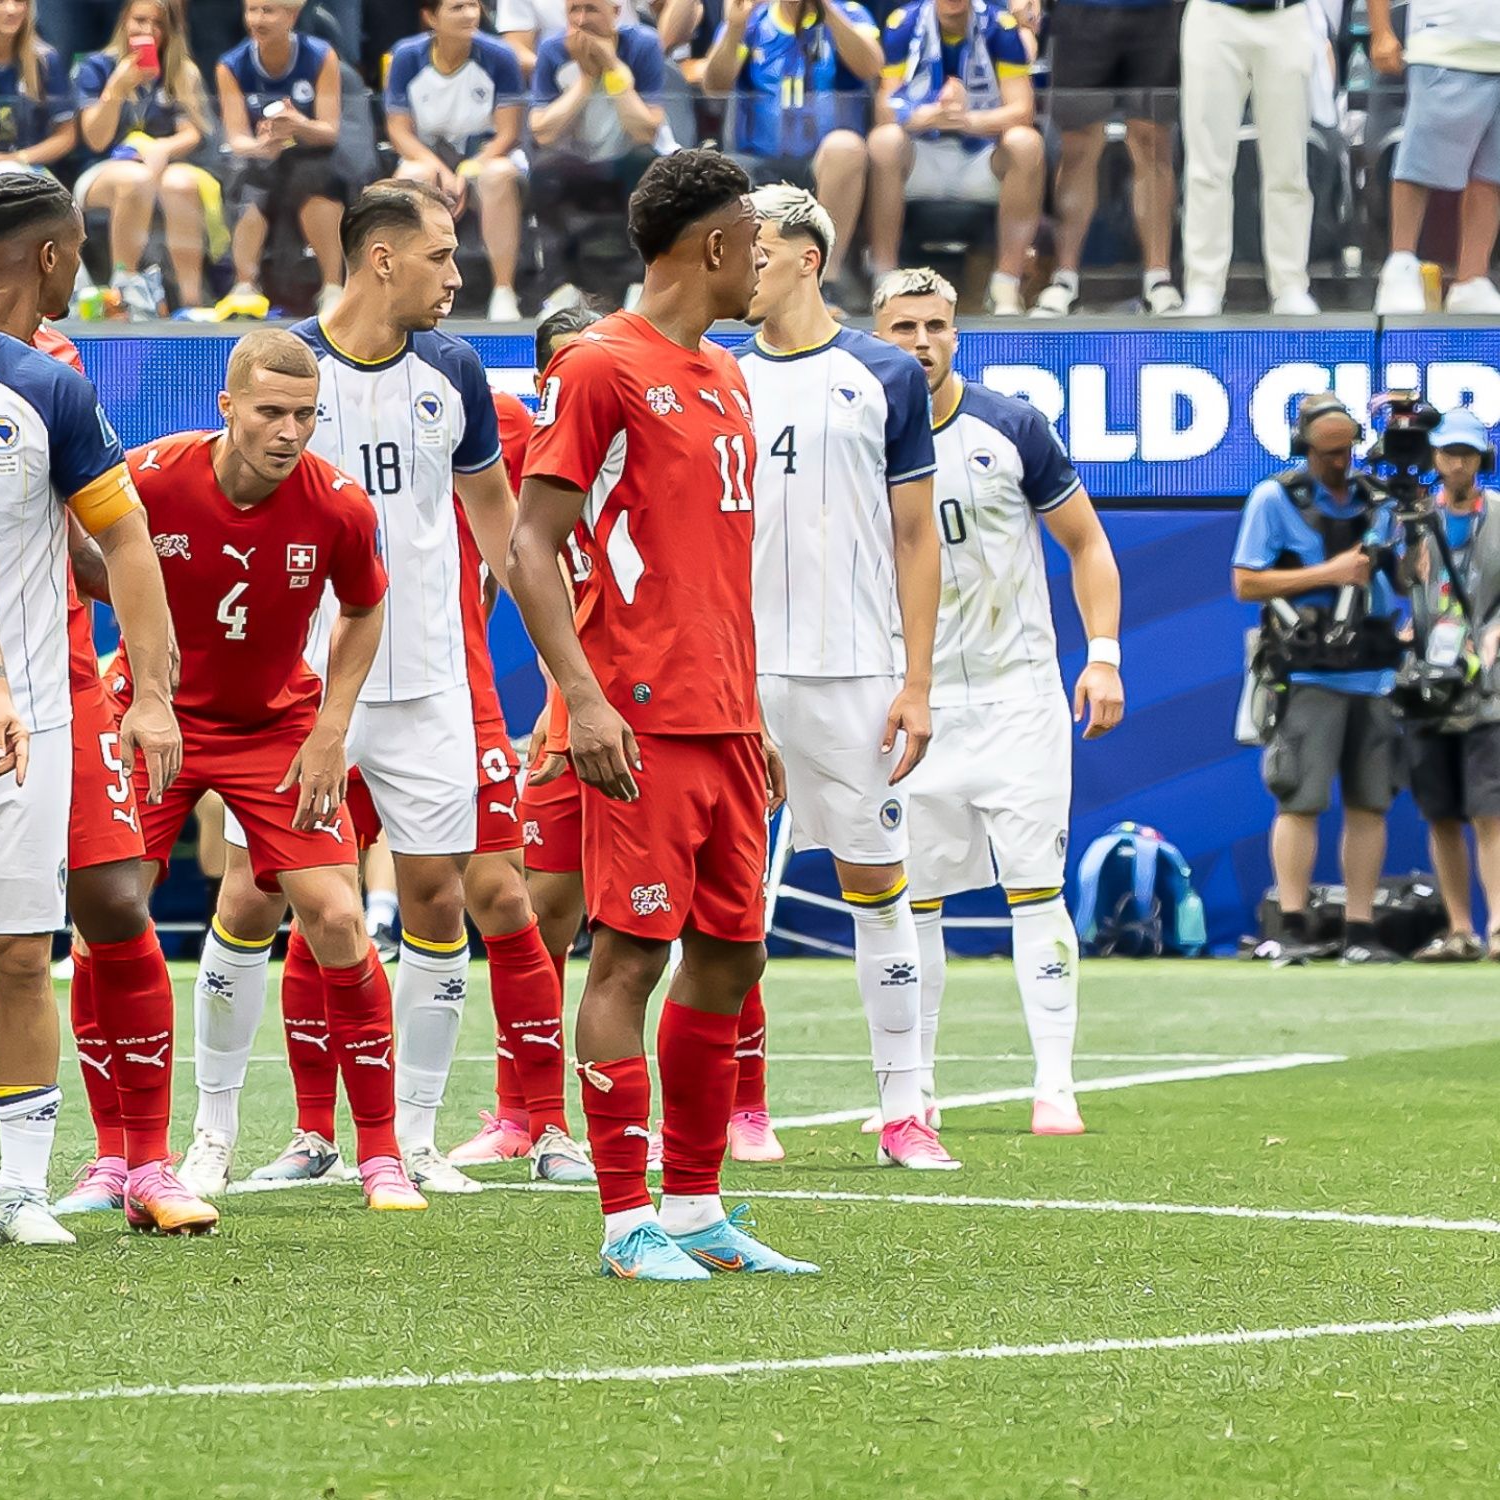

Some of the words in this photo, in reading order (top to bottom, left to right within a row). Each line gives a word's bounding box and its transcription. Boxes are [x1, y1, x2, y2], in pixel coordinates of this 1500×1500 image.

[983, 362, 1232, 463] RLD
[359, 441, 402, 496] 18
[712, 434, 753, 512] 11
[770, 424, 798, 475] 4
[216, 581, 250, 641] 4
[98, 732, 130, 803] 5
